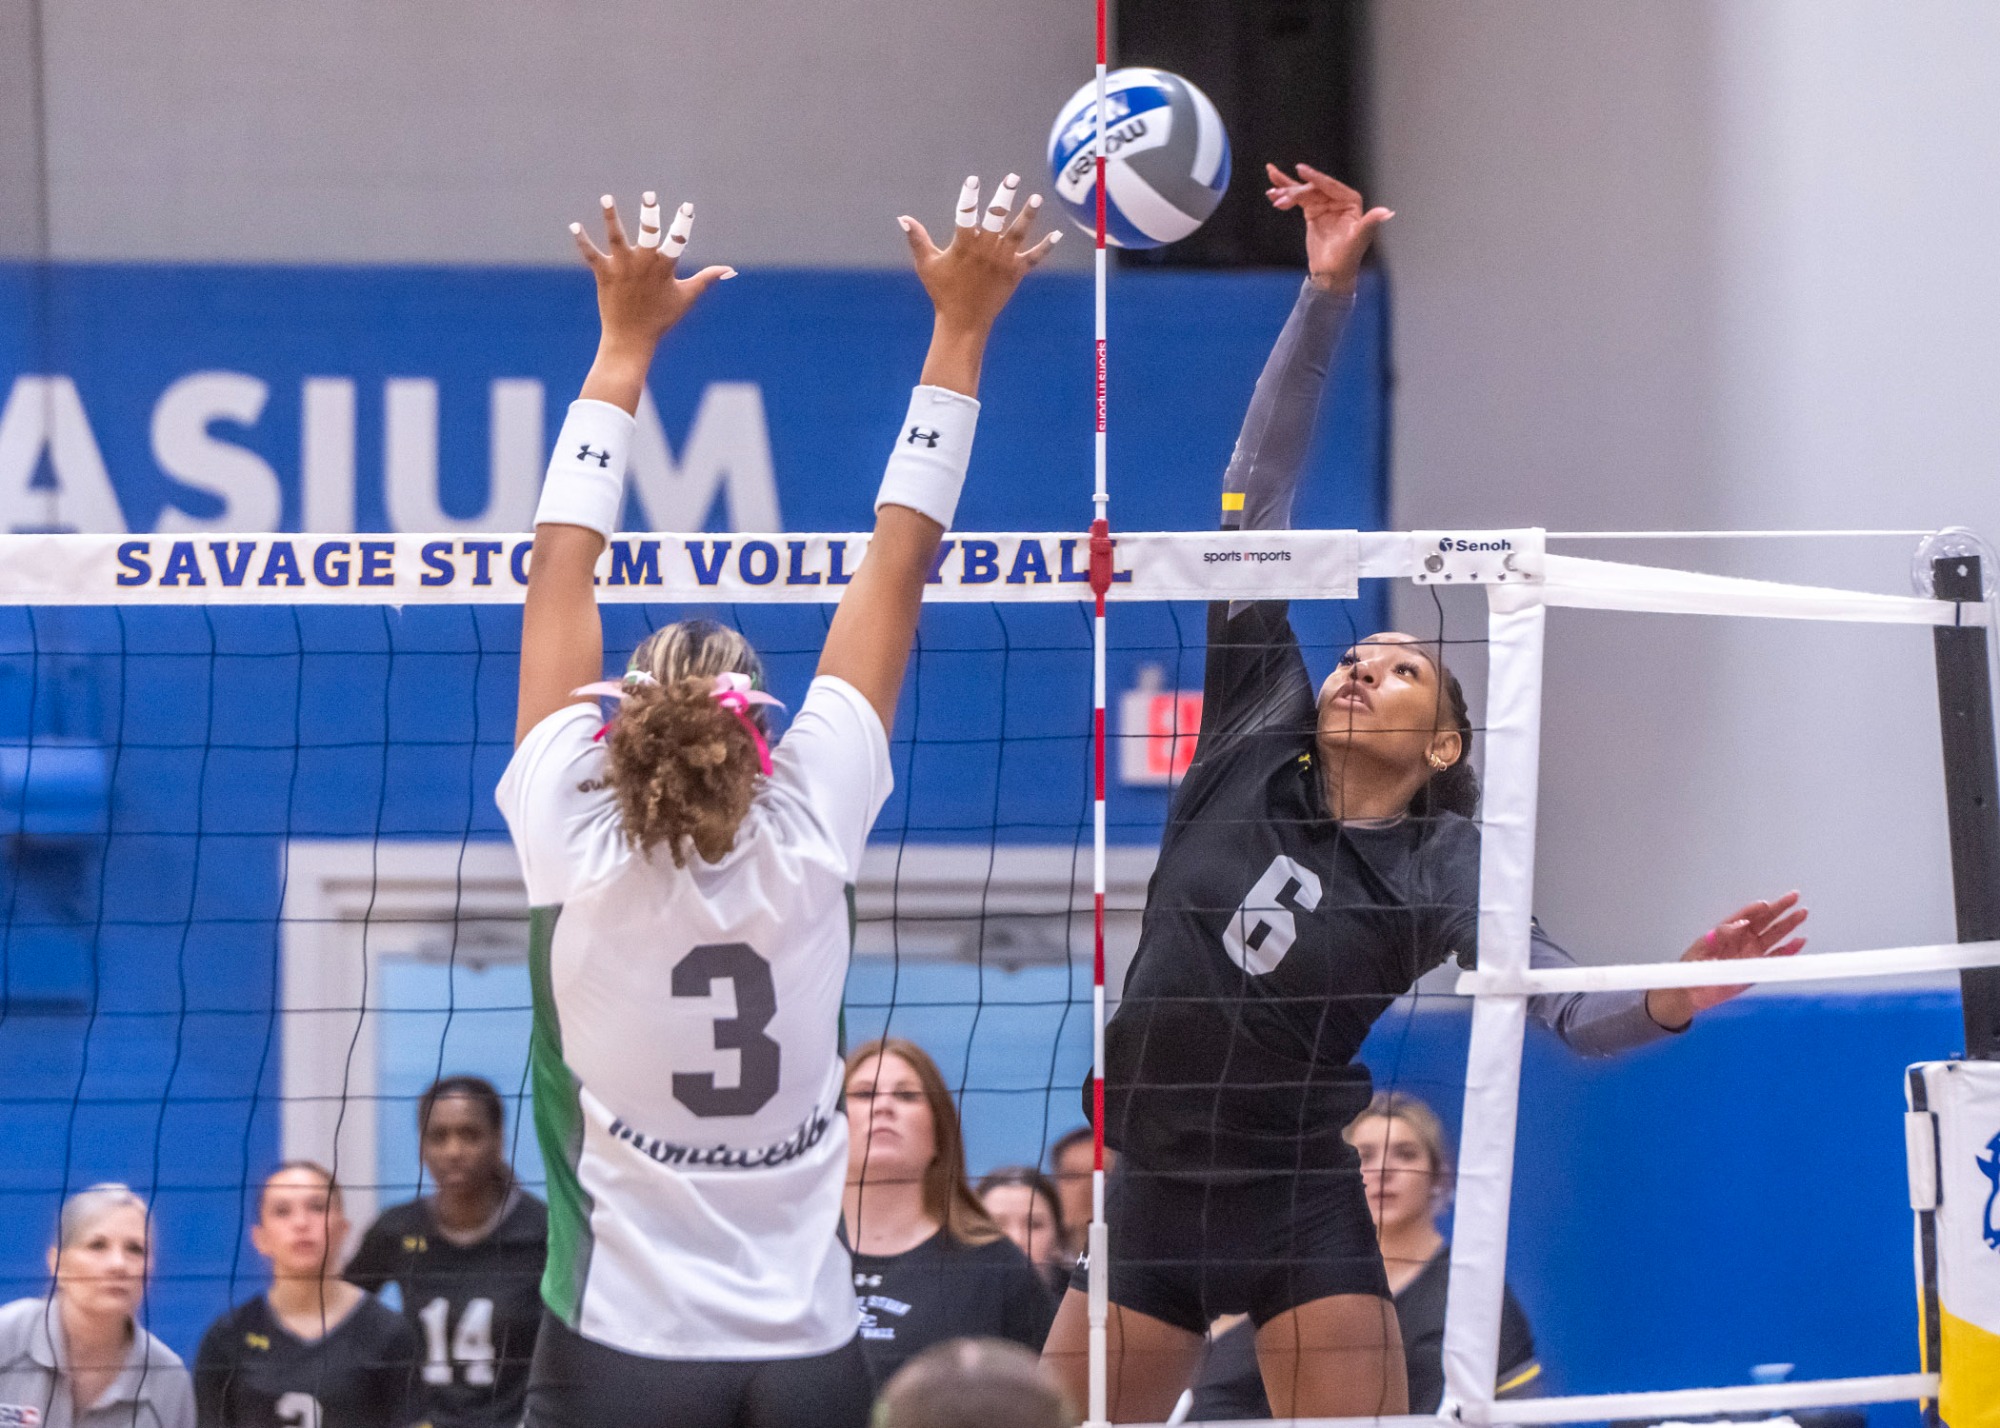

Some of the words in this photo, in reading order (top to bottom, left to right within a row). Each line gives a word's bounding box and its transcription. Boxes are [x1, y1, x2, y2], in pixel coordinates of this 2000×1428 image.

[1066, 118, 1149, 185] moten
[116, 541, 396, 588] SAVAGE
[419, 540, 664, 587] STOM
[684, 539, 1133, 585] VOLLYBALL
[1203, 550, 1242, 564] sports
[1244, 550, 1291, 563] imports
[1456, 539, 1511, 552] Senoh
[1222, 854, 1323, 976] 6
[671, 942, 781, 1118] 3
[419, 1298, 496, 1386] 14
